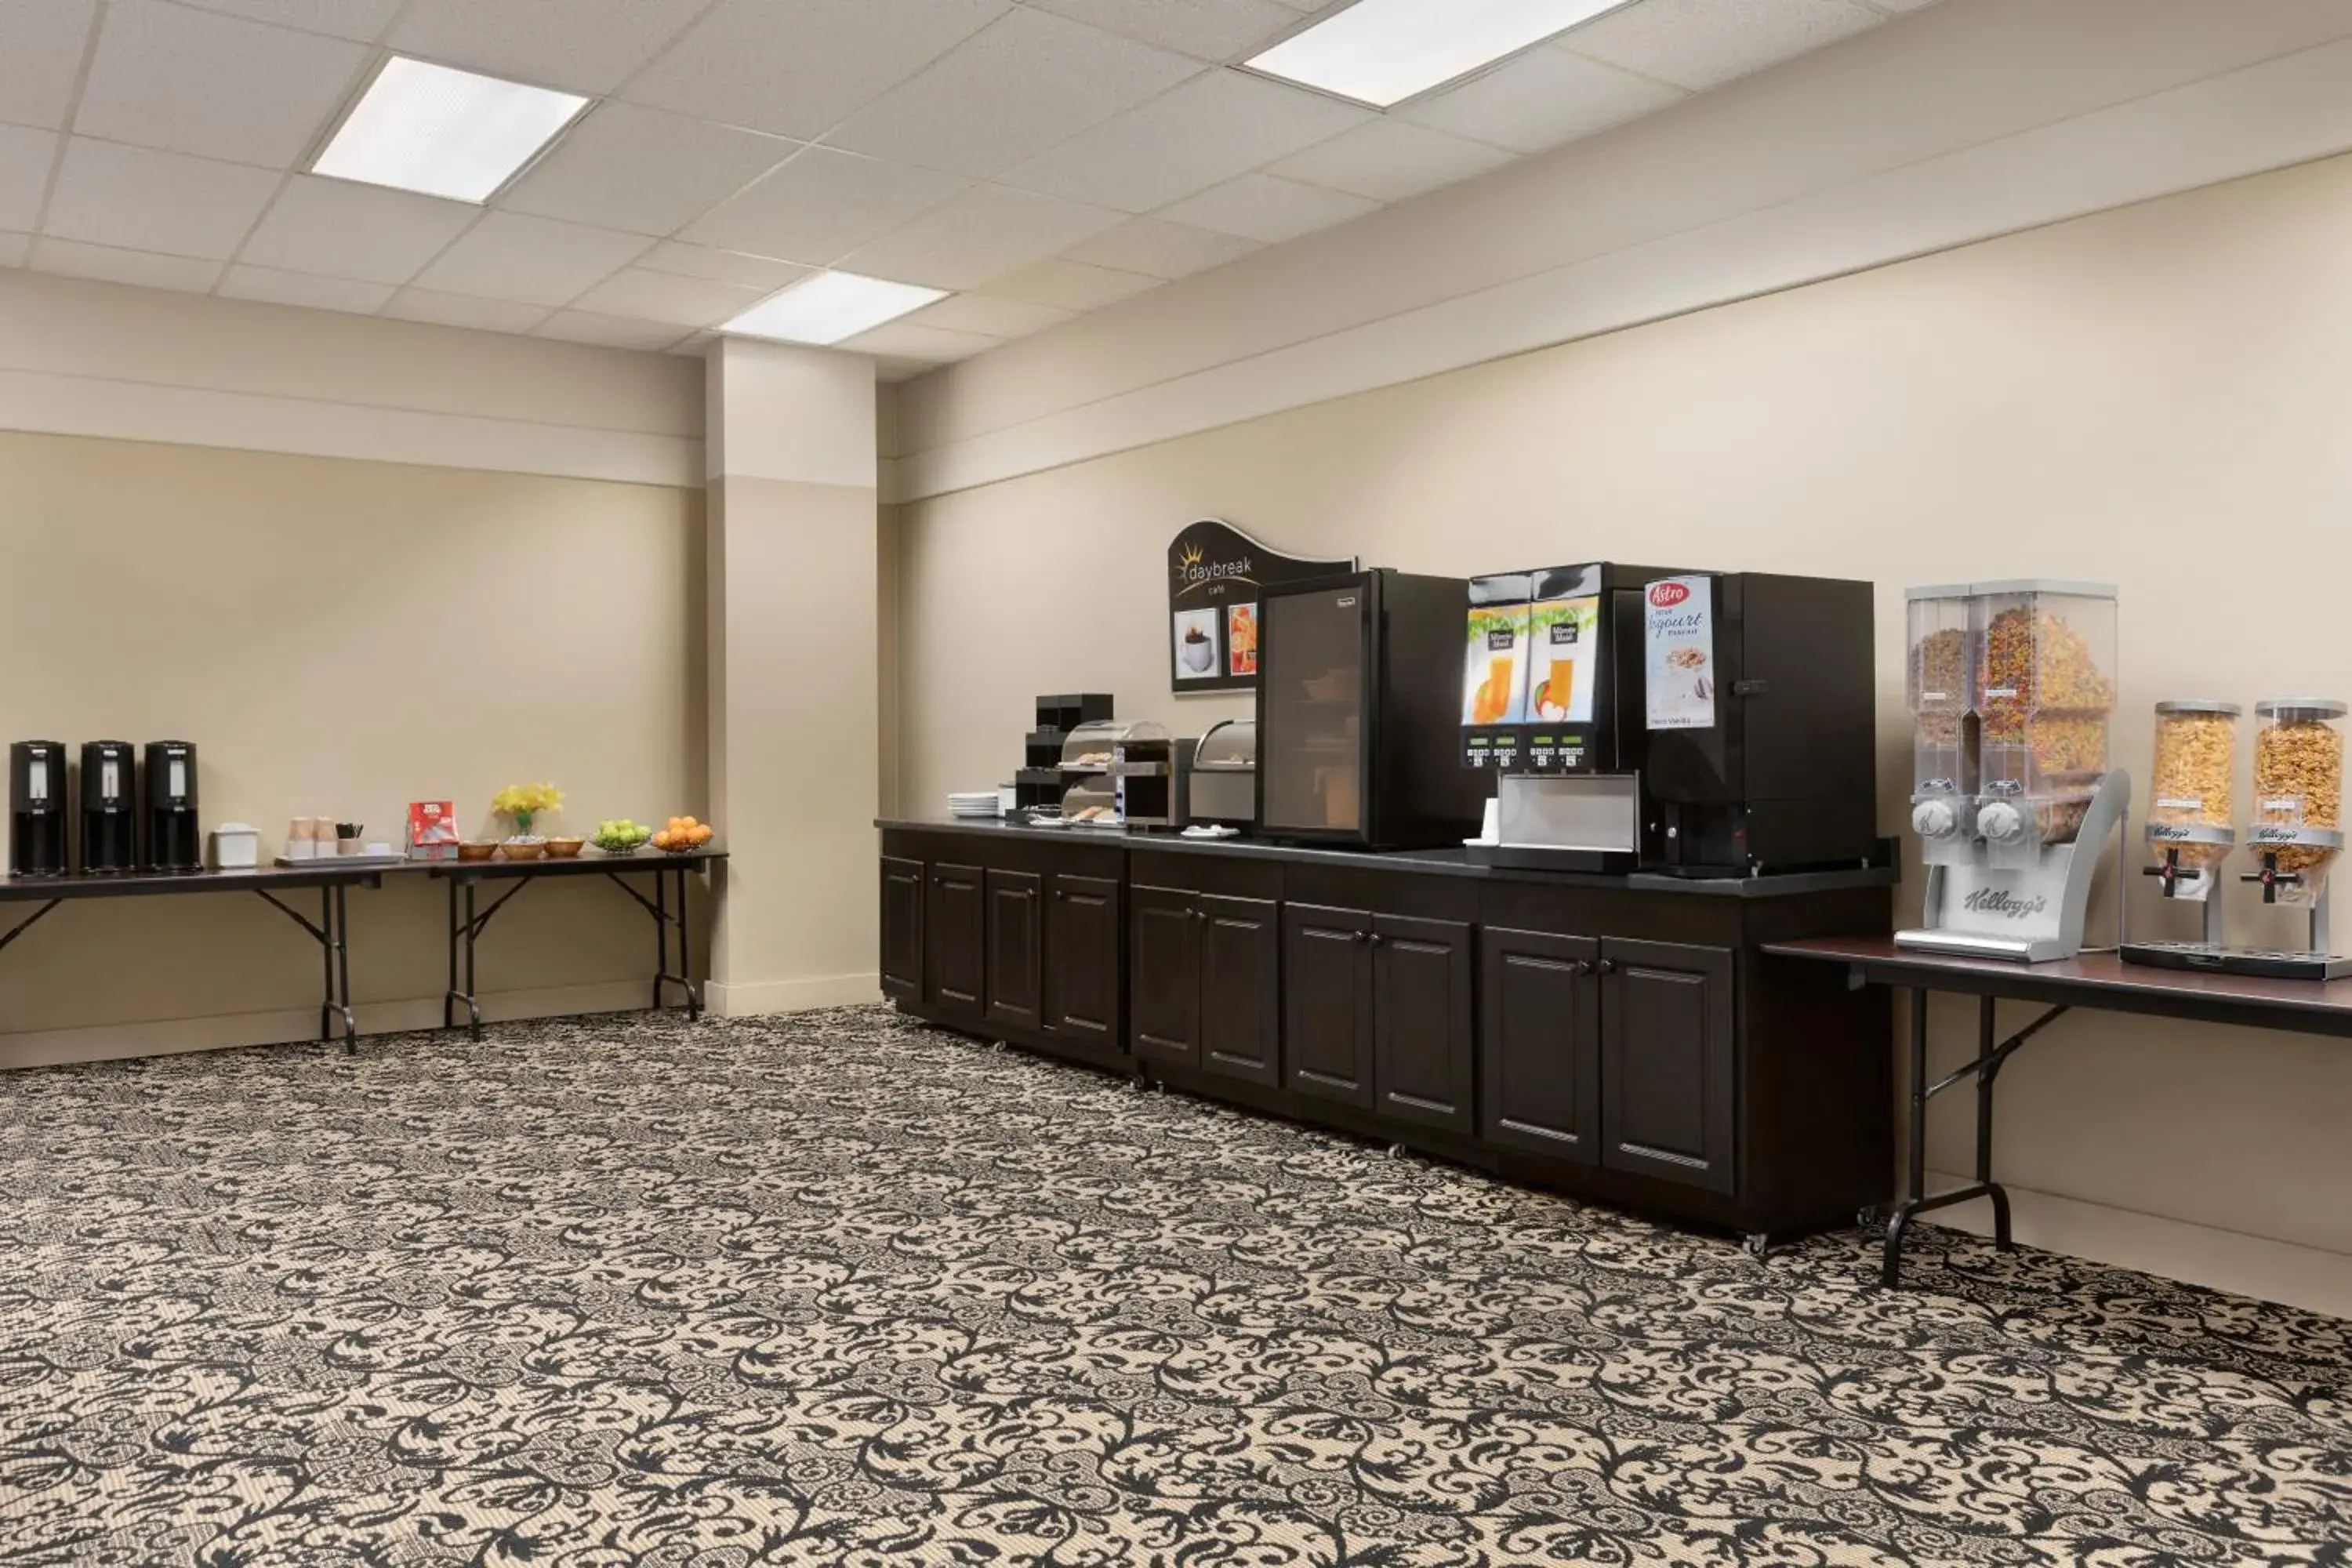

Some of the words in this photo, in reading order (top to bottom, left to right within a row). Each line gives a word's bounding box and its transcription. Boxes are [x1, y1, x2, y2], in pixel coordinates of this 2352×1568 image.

[1189, 556, 1251, 583] daybreak
[1652, 585, 1683, 604] Astro
[2154, 826, 2190, 838] Kellogg's
[2258, 828, 2298, 840] Kellogg's
[1964, 887, 2047, 919] Kellogg's
